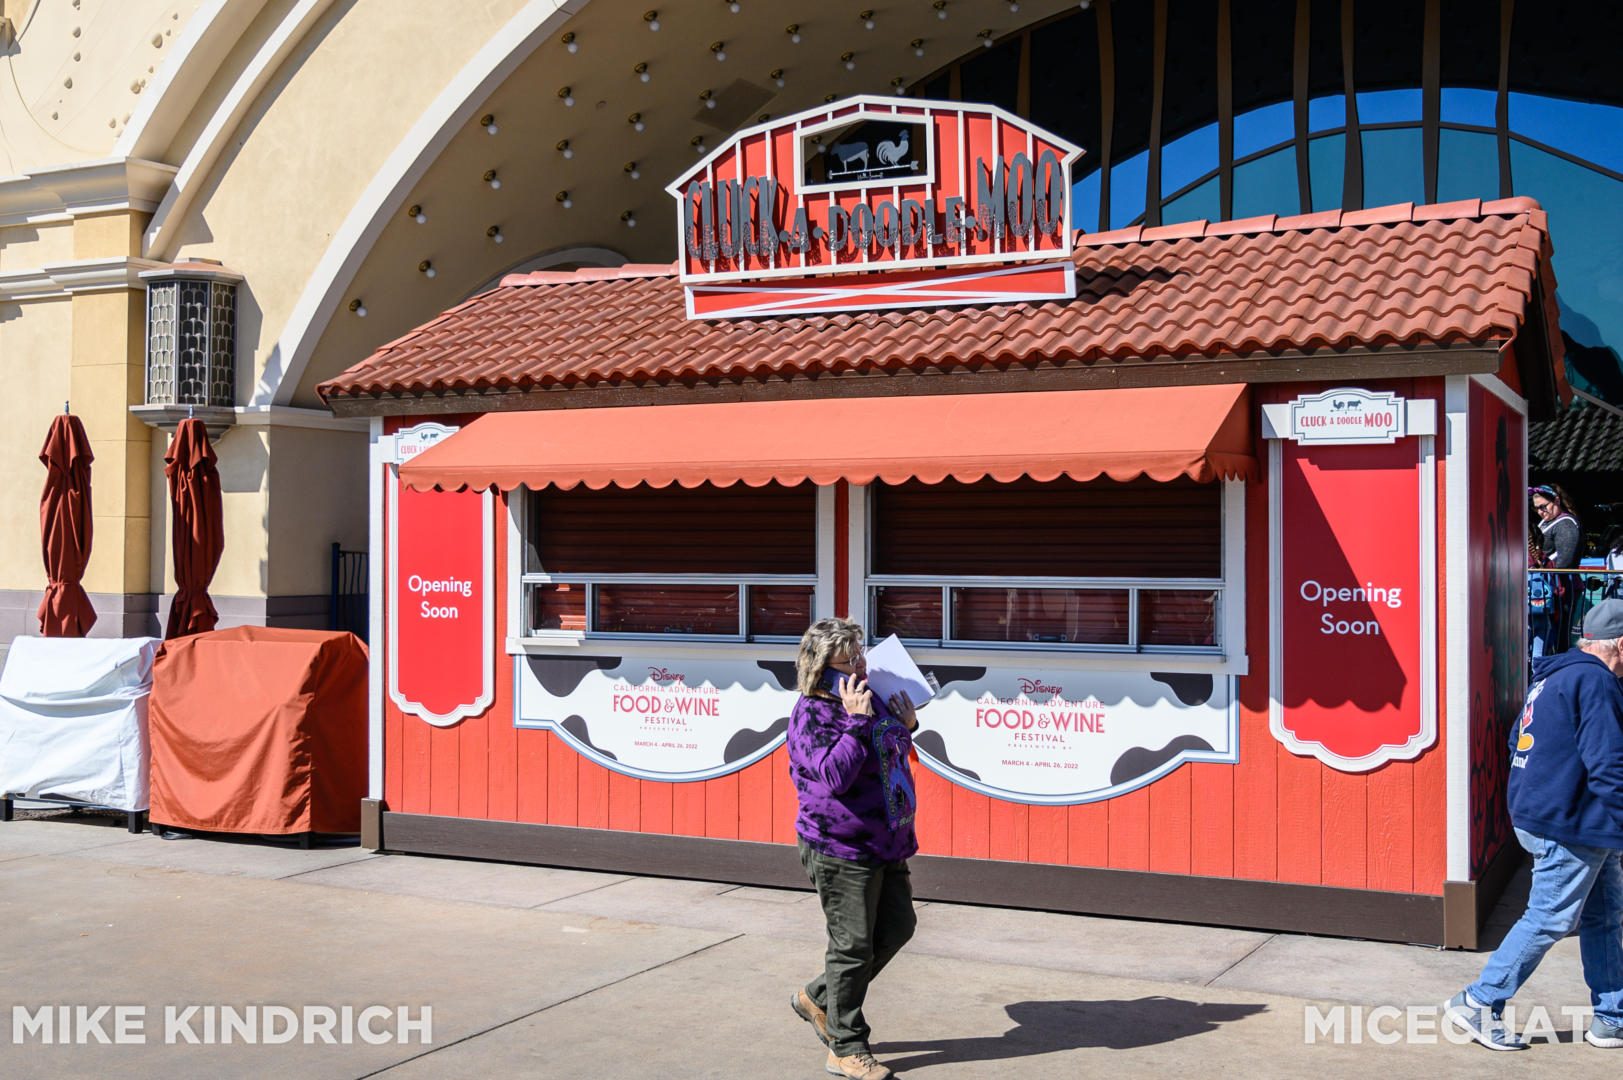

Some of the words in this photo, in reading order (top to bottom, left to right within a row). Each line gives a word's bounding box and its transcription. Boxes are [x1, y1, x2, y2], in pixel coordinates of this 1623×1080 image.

[686, 175, 781, 260] CLUCK
[789, 207, 810, 253] A
[827, 196, 966, 251] DOODLE
[976, 149, 1062, 241] MOO
[1300, 415, 1327, 427] CLUCK
[1329, 416, 1335, 425] A
[1336, 416, 1363, 425] DOODLE
[1364, 412, 1393, 428] MOO
[407, 574, 473, 597] Opening
[1300, 580, 1402, 608] Opening
[420, 600, 459, 620] Soon
[1320, 613, 1380, 635] Soon
[648, 666, 685, 685] Disney
[613, 684, 665, 693] CALIFORNIA
[669, 685, 720, 695] ADVENTURE
[1017, 677, 1063, 699] Disney
[613, 694, 661, 714] FOOD
[664, 698, 675, 713] &
[675, 696, 720, 717] WINE
[976, 696, 1039, 706] CALIFORNIA
[1043, 699, 1105, 709] ADVENTURE
[644, 716, 687, 726] FESTIVAL
[976, 708, 1034, 730] FOOD
[1037, 713, 1050, 729] &
[1050, 711, 1106, 734] WINE
[1014, 733, 1065, 743] FESTIVAL
